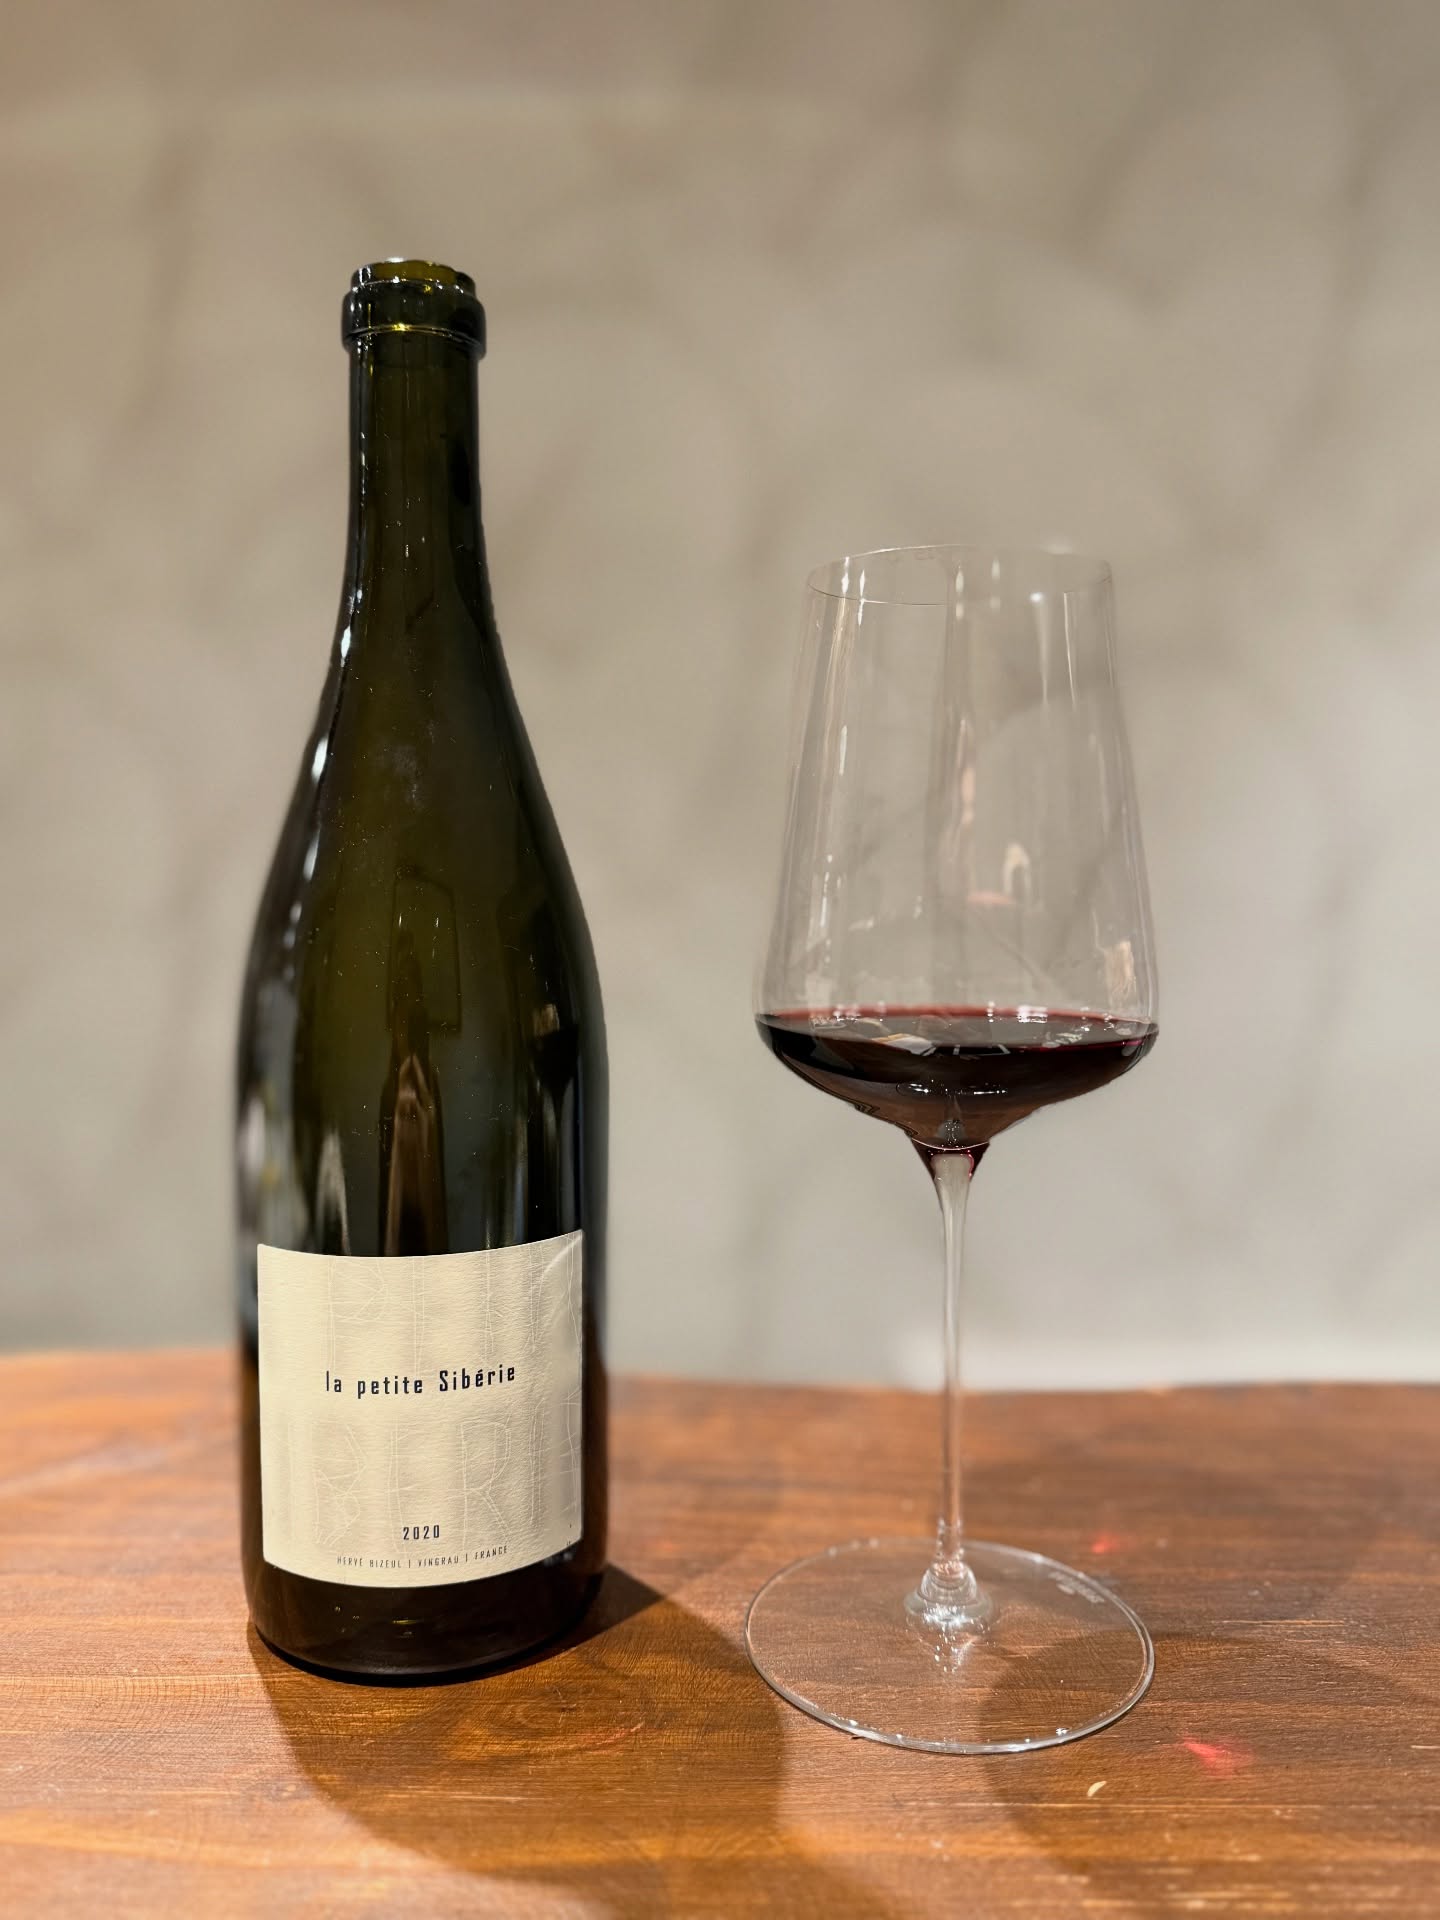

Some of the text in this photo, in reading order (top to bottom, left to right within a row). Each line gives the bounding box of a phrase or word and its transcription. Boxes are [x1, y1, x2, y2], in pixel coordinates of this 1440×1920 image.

[326, 1364, 515, 1399] la petite Sibérie
[403, 1524, 440, 1541] 2020
[369, 1559, 402, 1569] BIZEUL
[418, 1555, 459, 1567] VINGRAU
[475, 1545, 508, 1560] FRANCE
